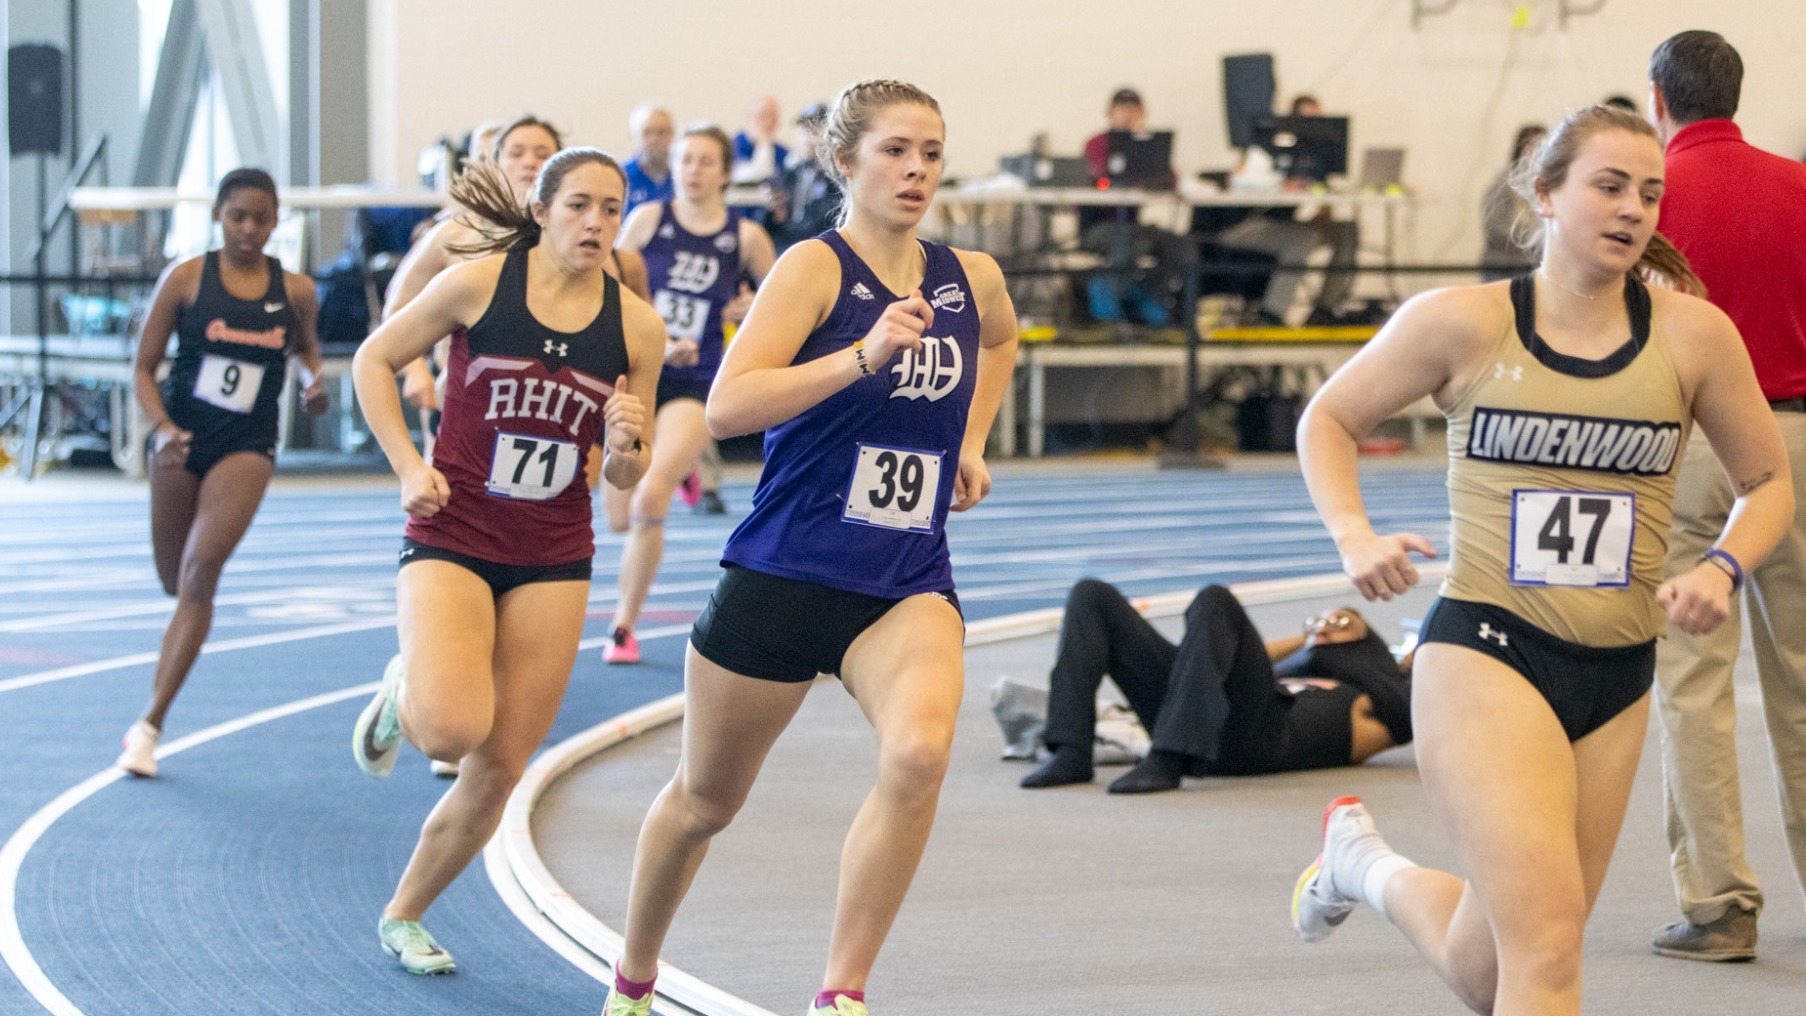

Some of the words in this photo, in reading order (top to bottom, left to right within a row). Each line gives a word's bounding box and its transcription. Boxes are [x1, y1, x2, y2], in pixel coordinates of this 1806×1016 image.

[663, 297, 696, 330] 33
[220, 364, 241, 397] 9
[484, 377, 599, 437] RHIT
[512, 438, 559, 488] 71
[1471, 412, 1681, 474] LINDENWOOD
[868, 451, 924, 512] 39
[1537, 496, 1612, 565] 47
